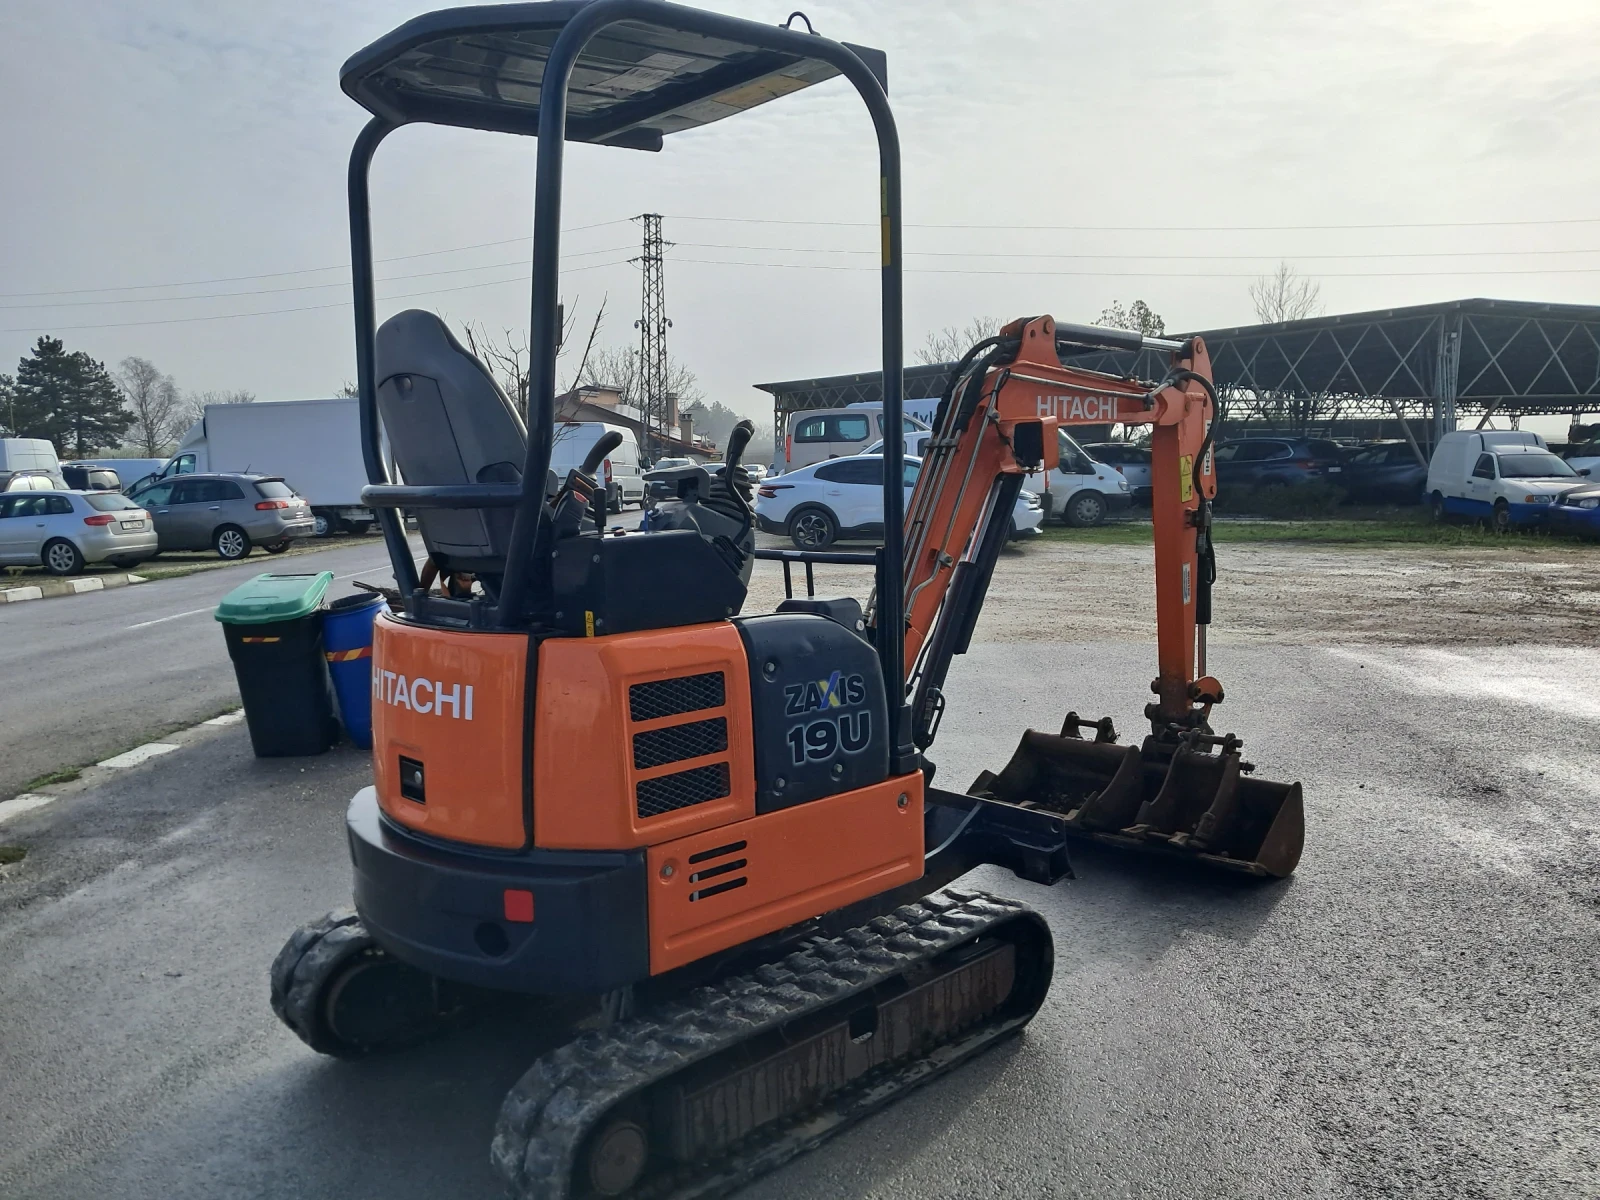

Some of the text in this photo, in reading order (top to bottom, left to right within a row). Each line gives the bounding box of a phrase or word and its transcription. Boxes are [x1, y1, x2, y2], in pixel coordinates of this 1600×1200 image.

[1037, 396, 1117, 419] HITACHI
[372, 665, 473, 720] HITACHI
[784, 670, 866, 717] ZAXIS
[786, 710, 871, 766] 19U
